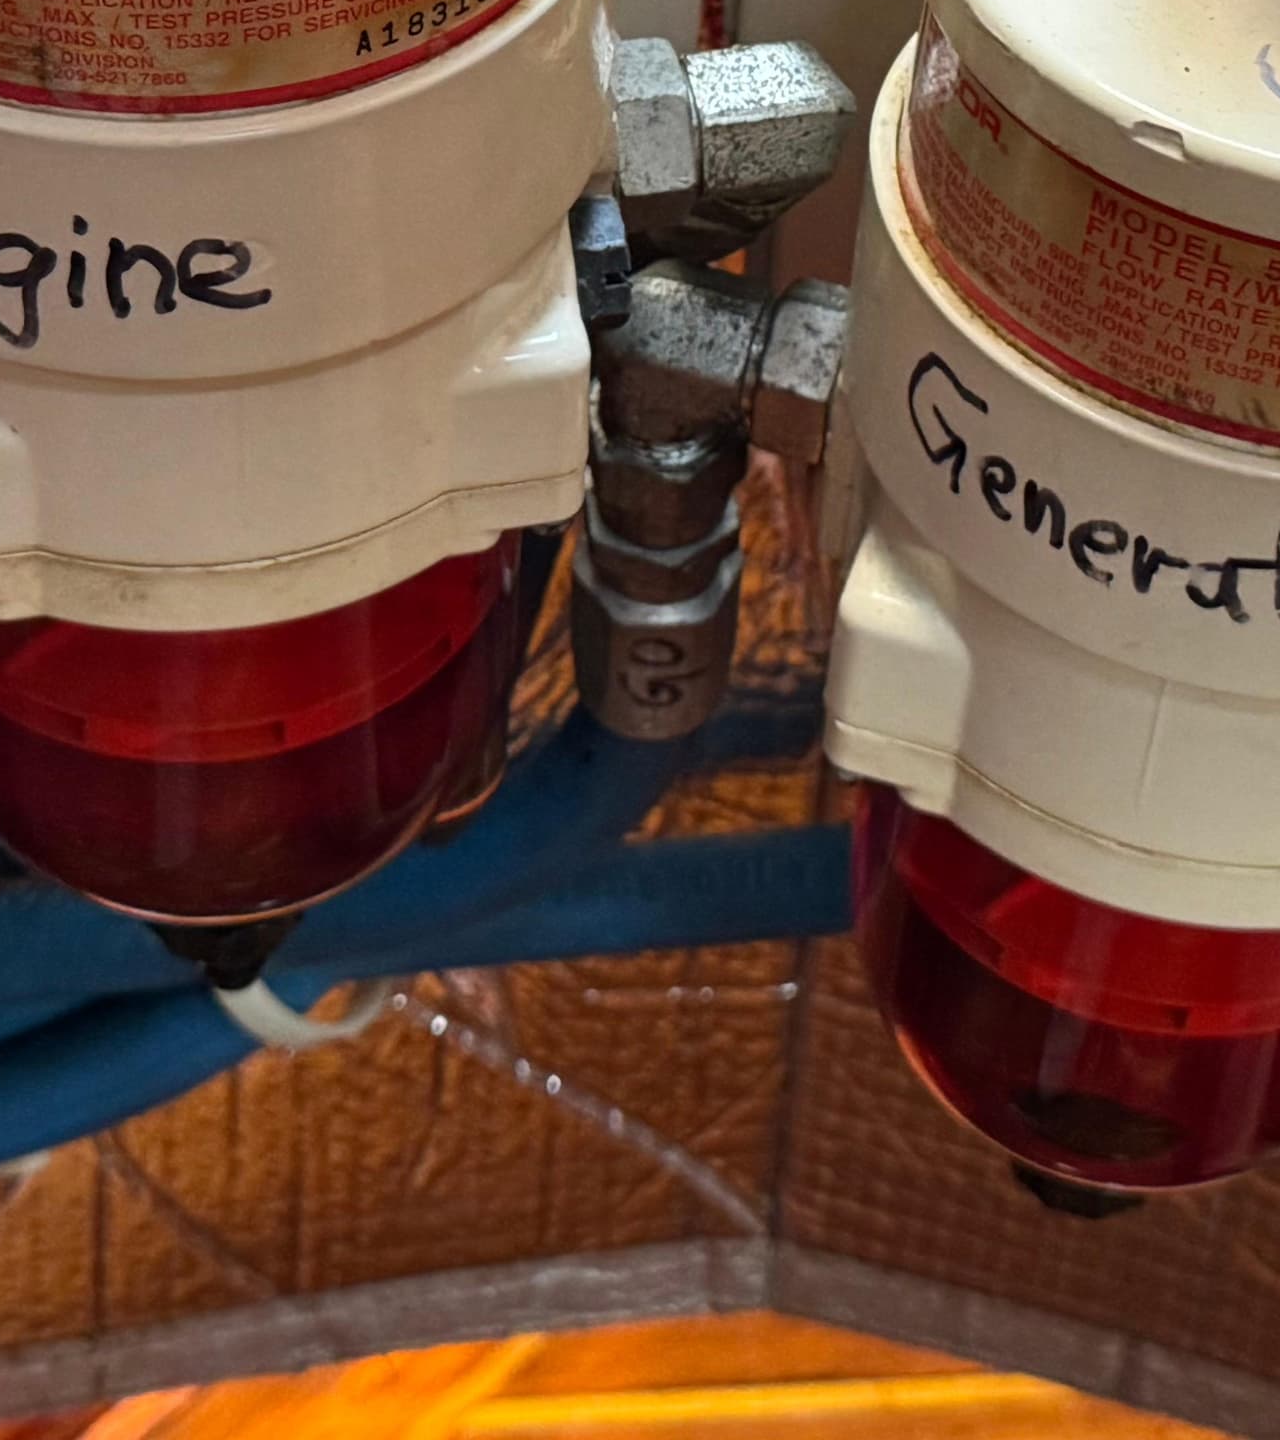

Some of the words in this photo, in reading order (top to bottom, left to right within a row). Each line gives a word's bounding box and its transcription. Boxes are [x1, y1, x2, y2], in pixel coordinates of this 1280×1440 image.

[129, 13, 192, 30] TEST
[164, 31, 231, 50] 15332
[244, 23, 292, 44] FOR
[61, 50, 155, 69] DIVISION
[1090, 189, 1233, 270] MODEL
[1081, 239, 1166, 292] FLOW
[1099, 277, 1241, 340] APPLICATION
[1179, 329, 1234, 357] TEST
[1205, 357, 1264, 385] 15332
